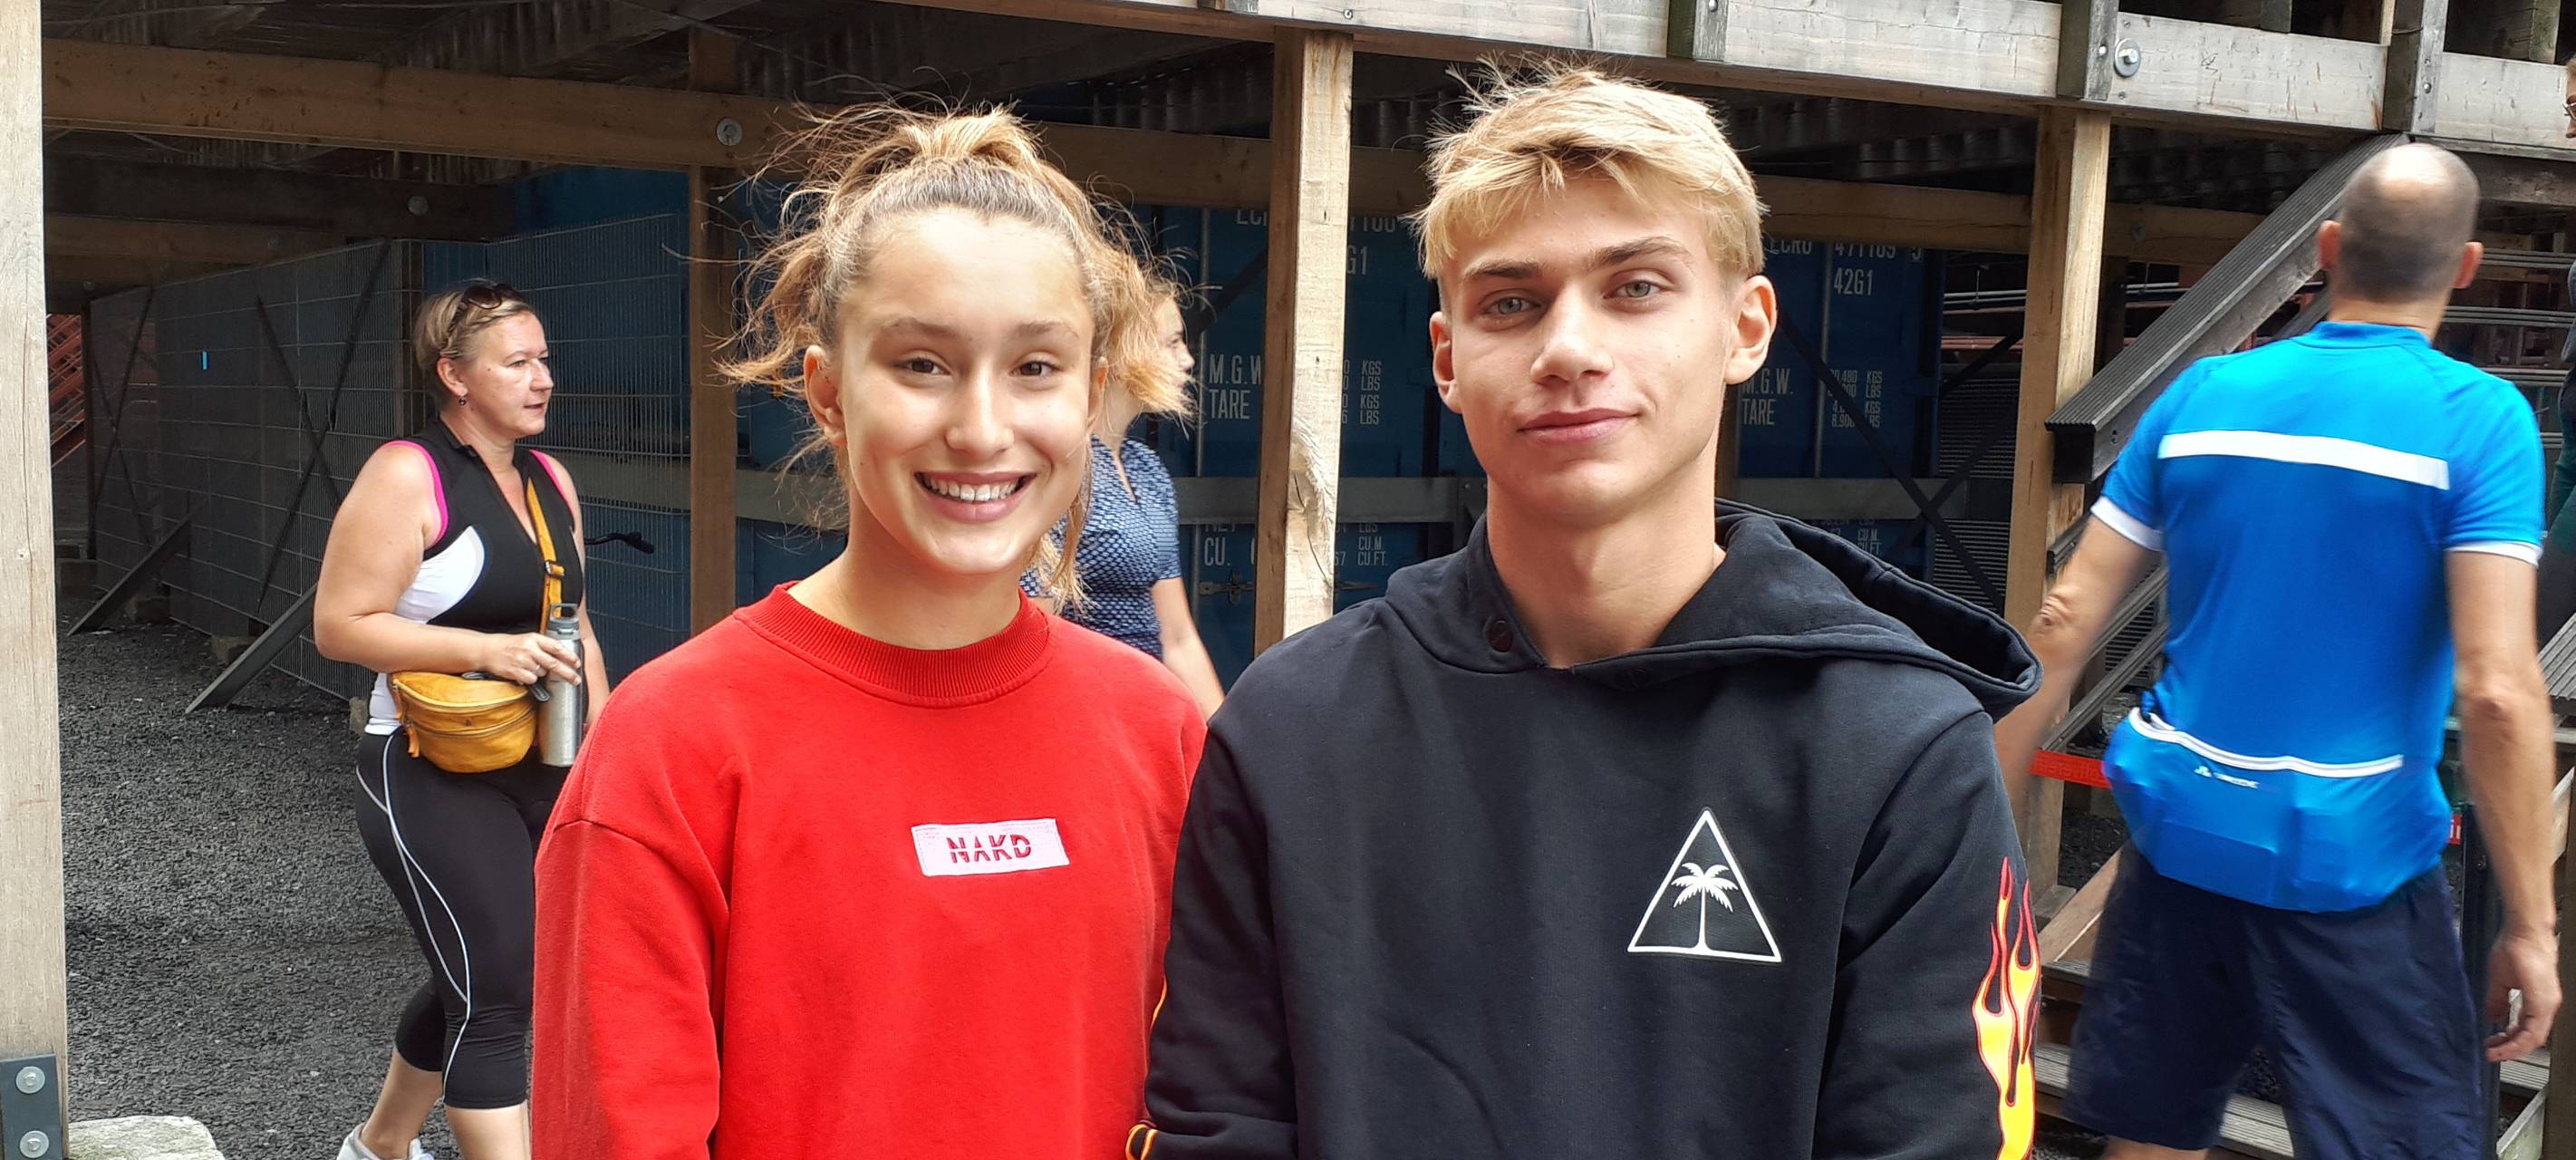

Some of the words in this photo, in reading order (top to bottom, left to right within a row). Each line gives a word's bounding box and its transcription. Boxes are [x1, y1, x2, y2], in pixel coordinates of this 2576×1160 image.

[1834, 267, 1874, 295] 42G1
[1362, 360, 1383, 375] KGS
[1361, 376, 1381, 392] LBS
[1867, 370, 1883, 384] KGS
[1866, 384, 1882, 398] LBS
[1209, 389, 1251, 420] TARE
[1360, 393, 1380, 410] KGS
[1741, 399, 1777, 426] TARE
[1360, 410, 1379, 425] LBS
[946, 834, 1032, 863] NAKD
